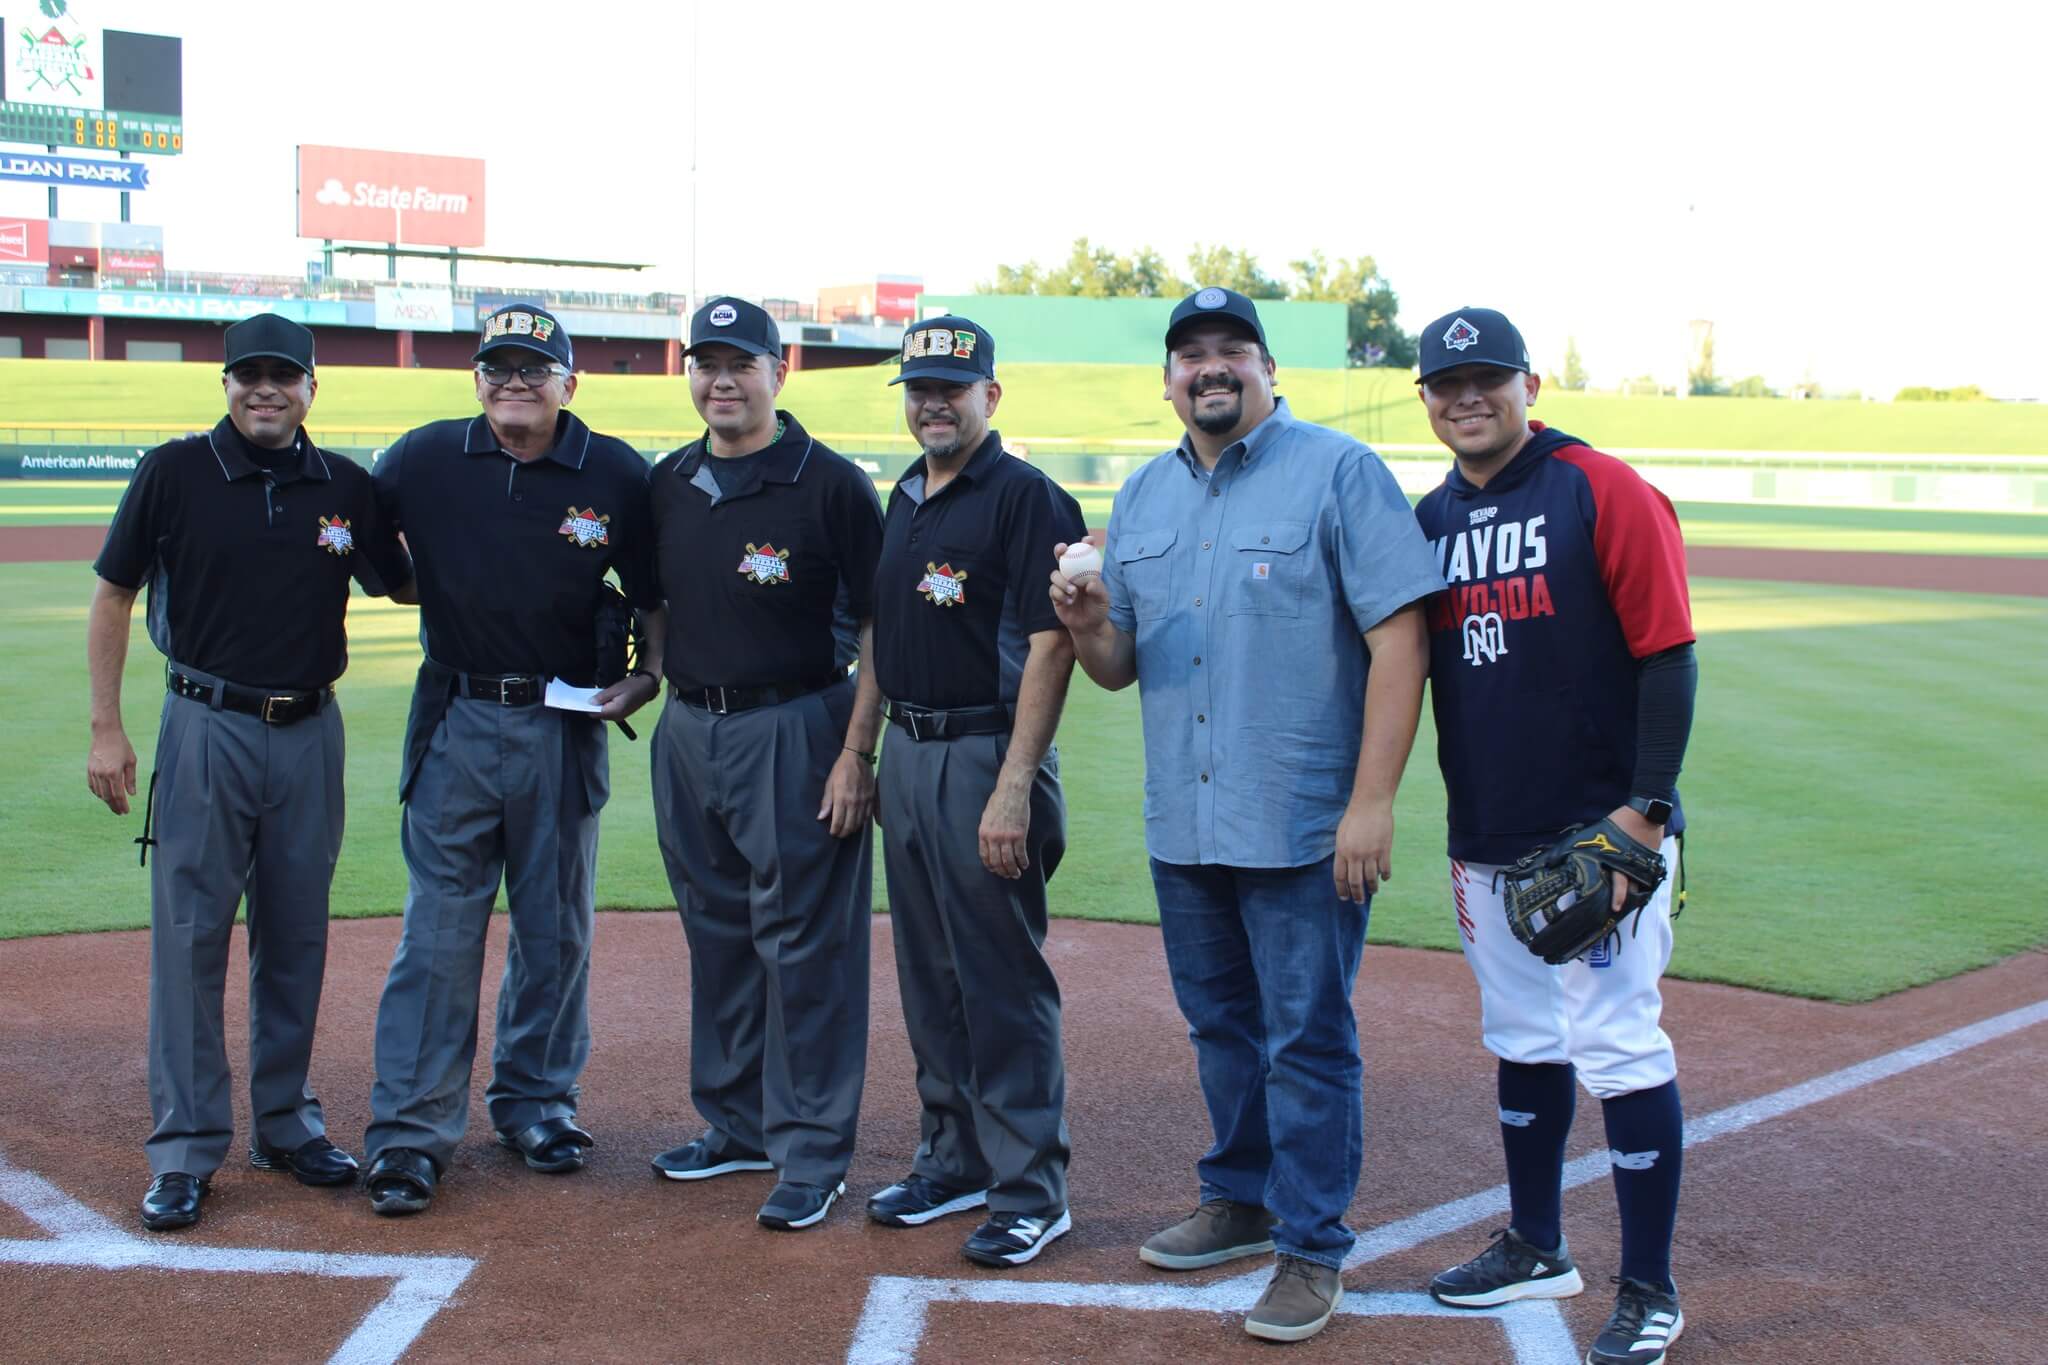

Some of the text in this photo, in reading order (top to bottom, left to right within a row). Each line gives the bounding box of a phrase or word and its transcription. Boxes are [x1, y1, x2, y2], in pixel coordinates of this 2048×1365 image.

[68, 163, 132, 183] PARK
[97, 293, 275, 318] SLOAN PARK
[394, 304, 438, 320] MESA
[484, 312, 555, 343] MBF
[902, 329, 976, 362] MBF
[21, 455, 137, 469] American Airlines
